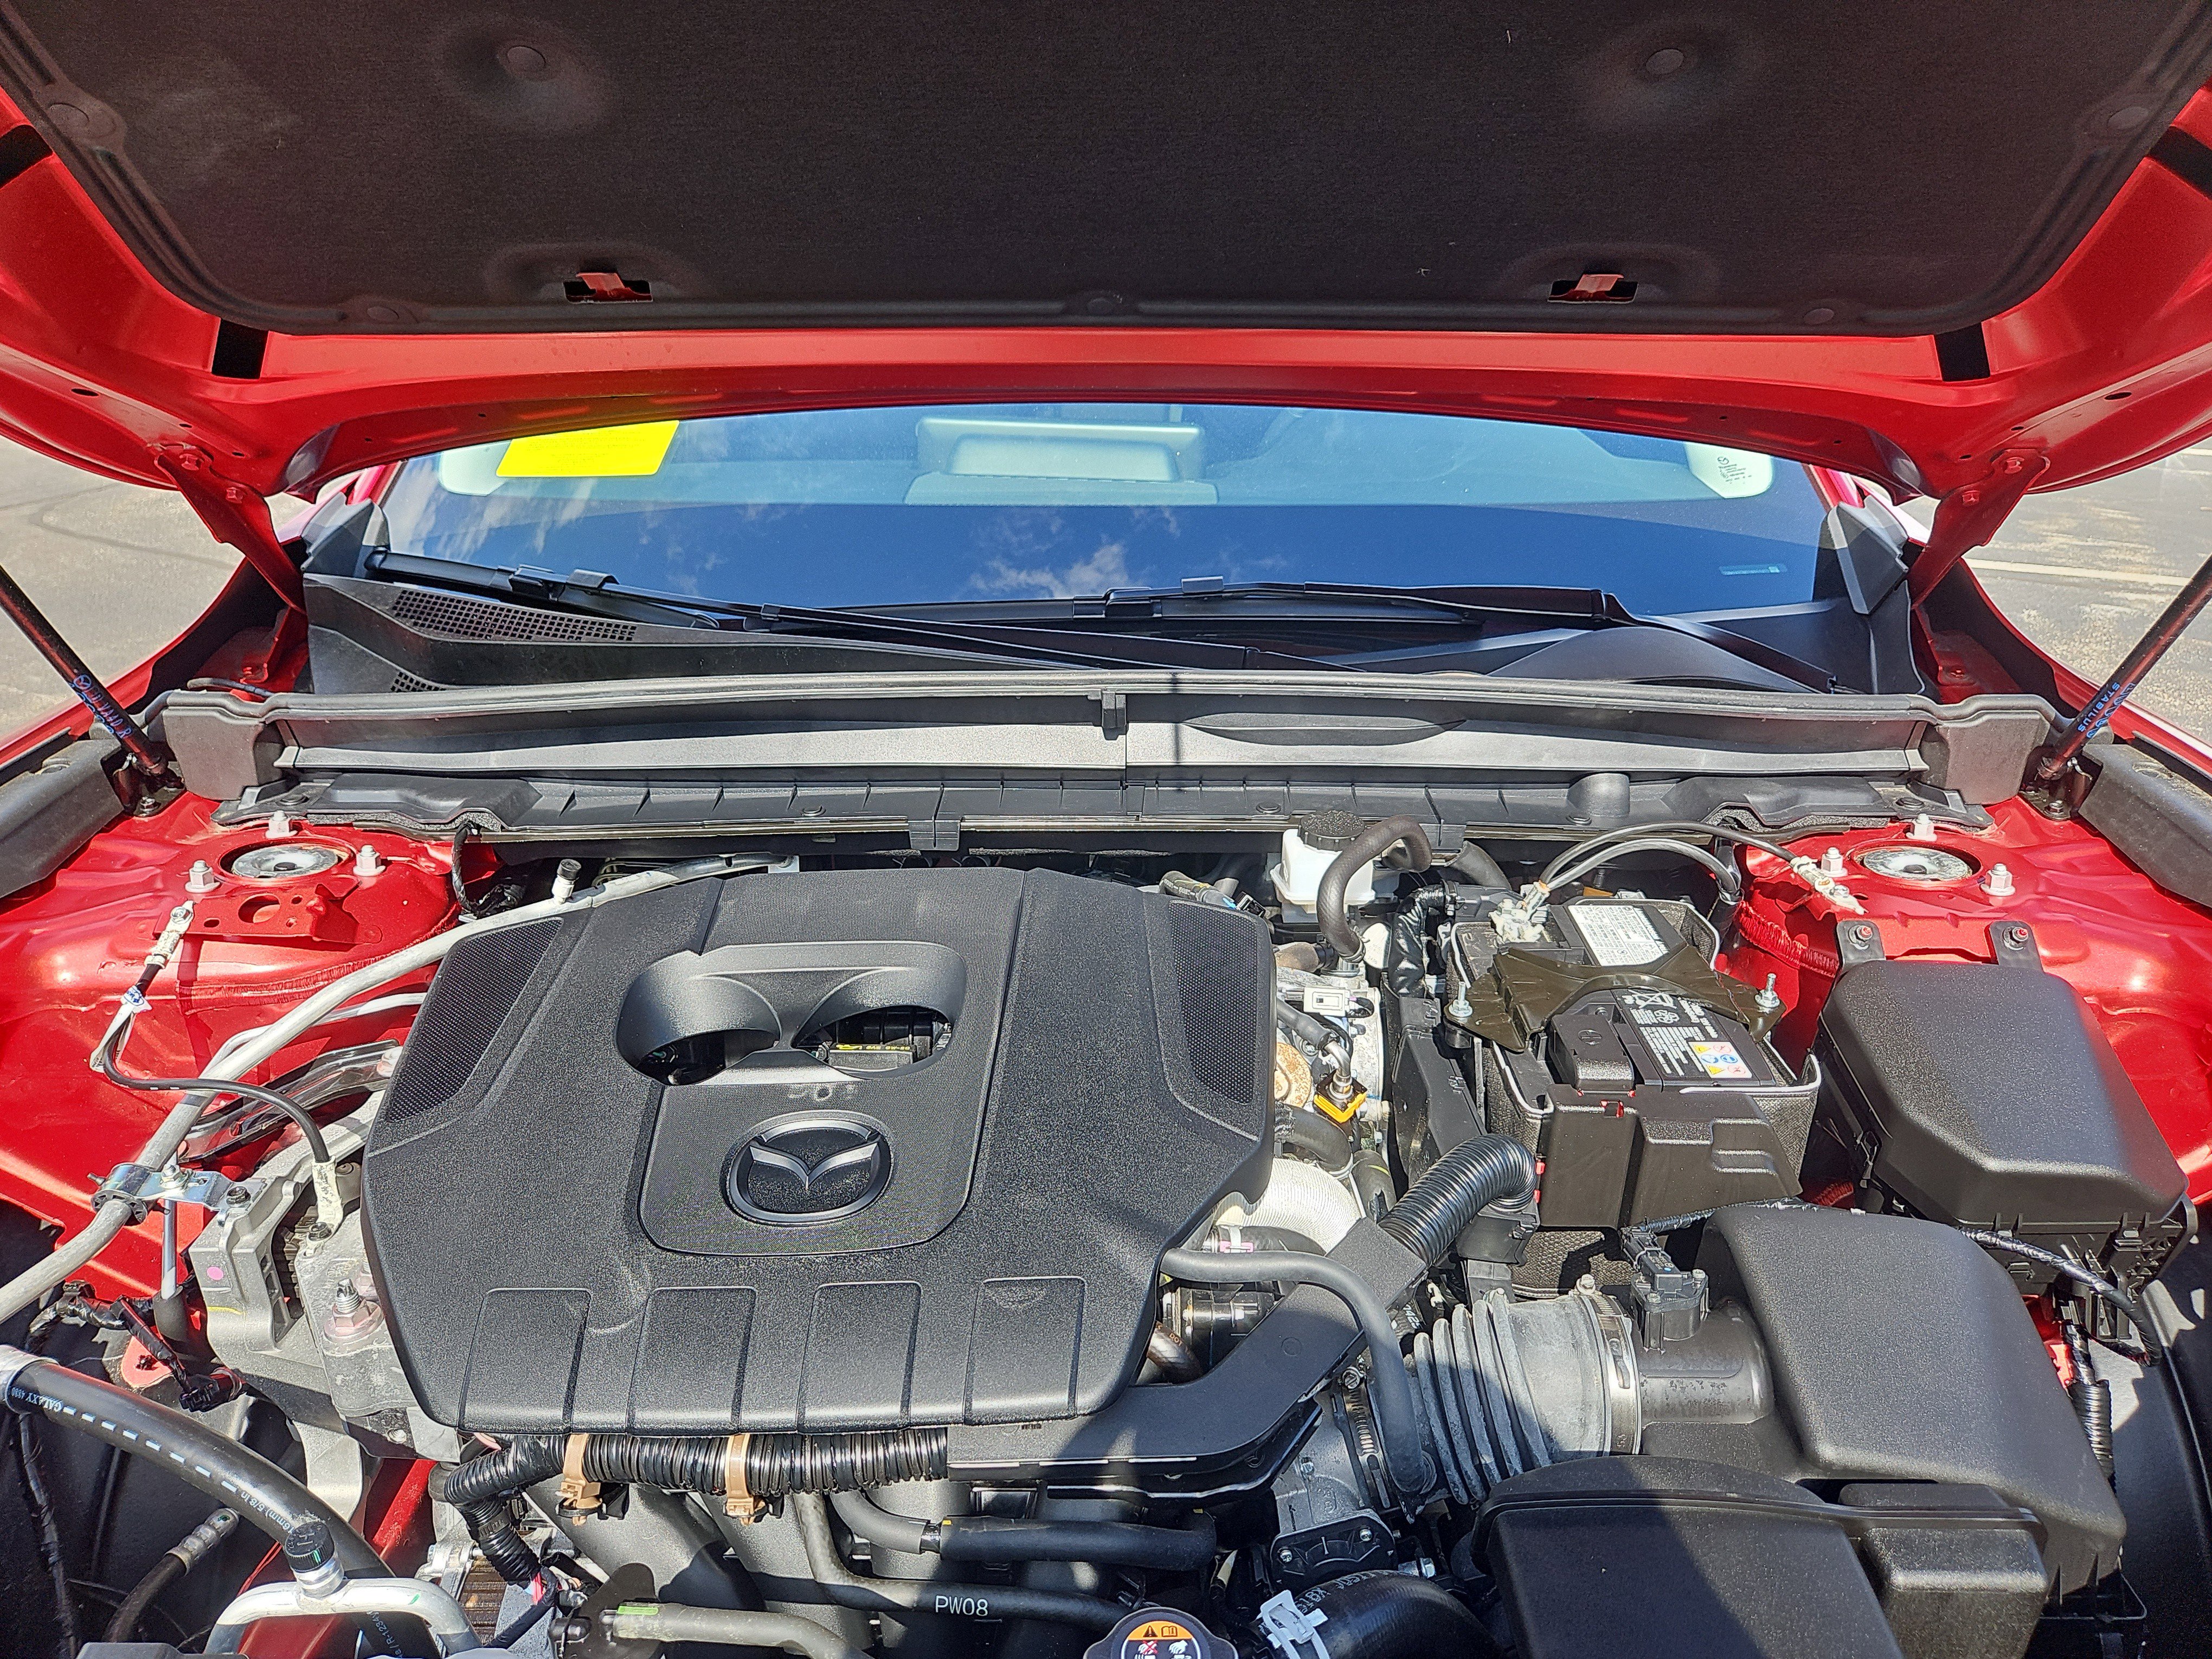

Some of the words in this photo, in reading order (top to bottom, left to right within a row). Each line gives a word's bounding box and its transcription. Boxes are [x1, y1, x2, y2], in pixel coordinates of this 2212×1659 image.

[2077, 682, 2120, 732] STABILUS
[25, 1392, 64, 1413] GALAXY
[935, 1595, 988, 1616] PW08
